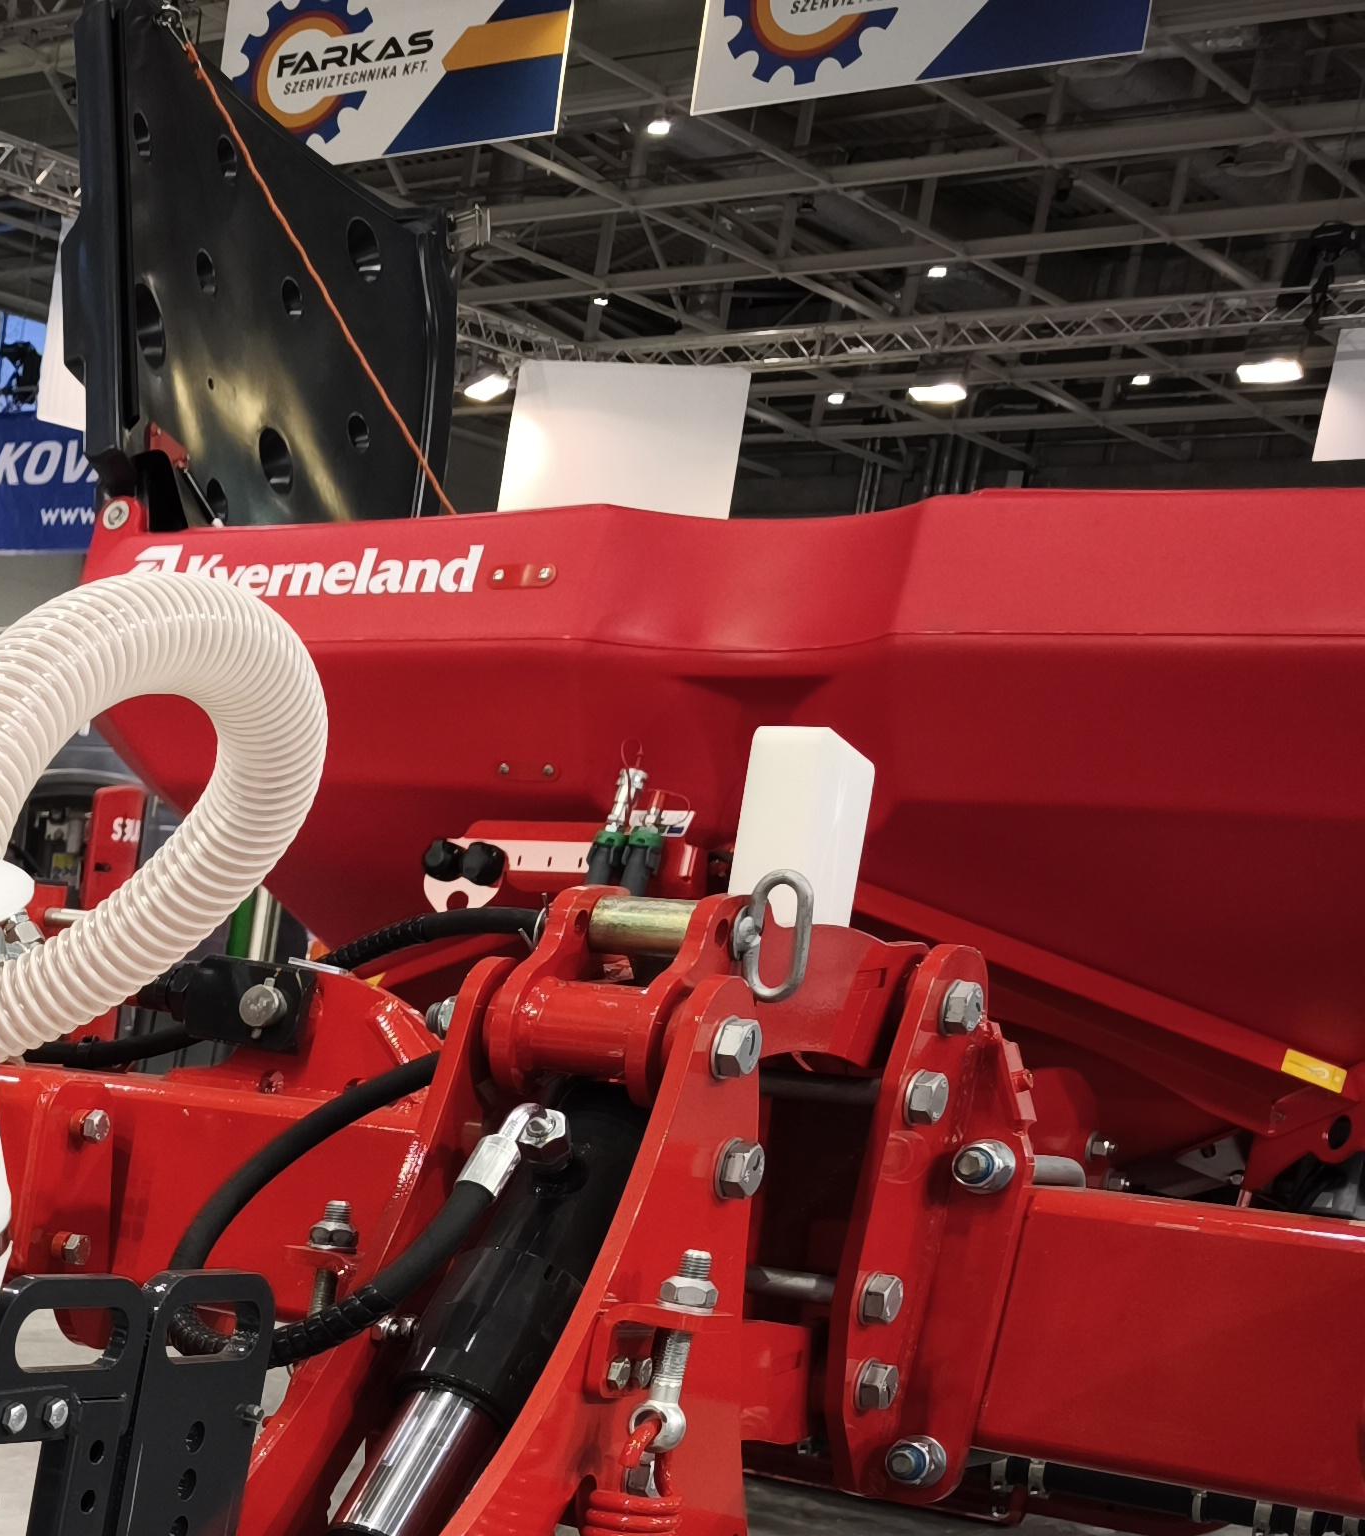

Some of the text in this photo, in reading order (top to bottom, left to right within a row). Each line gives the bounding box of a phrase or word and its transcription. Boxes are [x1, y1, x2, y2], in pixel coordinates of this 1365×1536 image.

[276, 29, 434, 79] FARKAS
[283, 59, 429, 96] SZERVIZTECHNIKA KFT.
